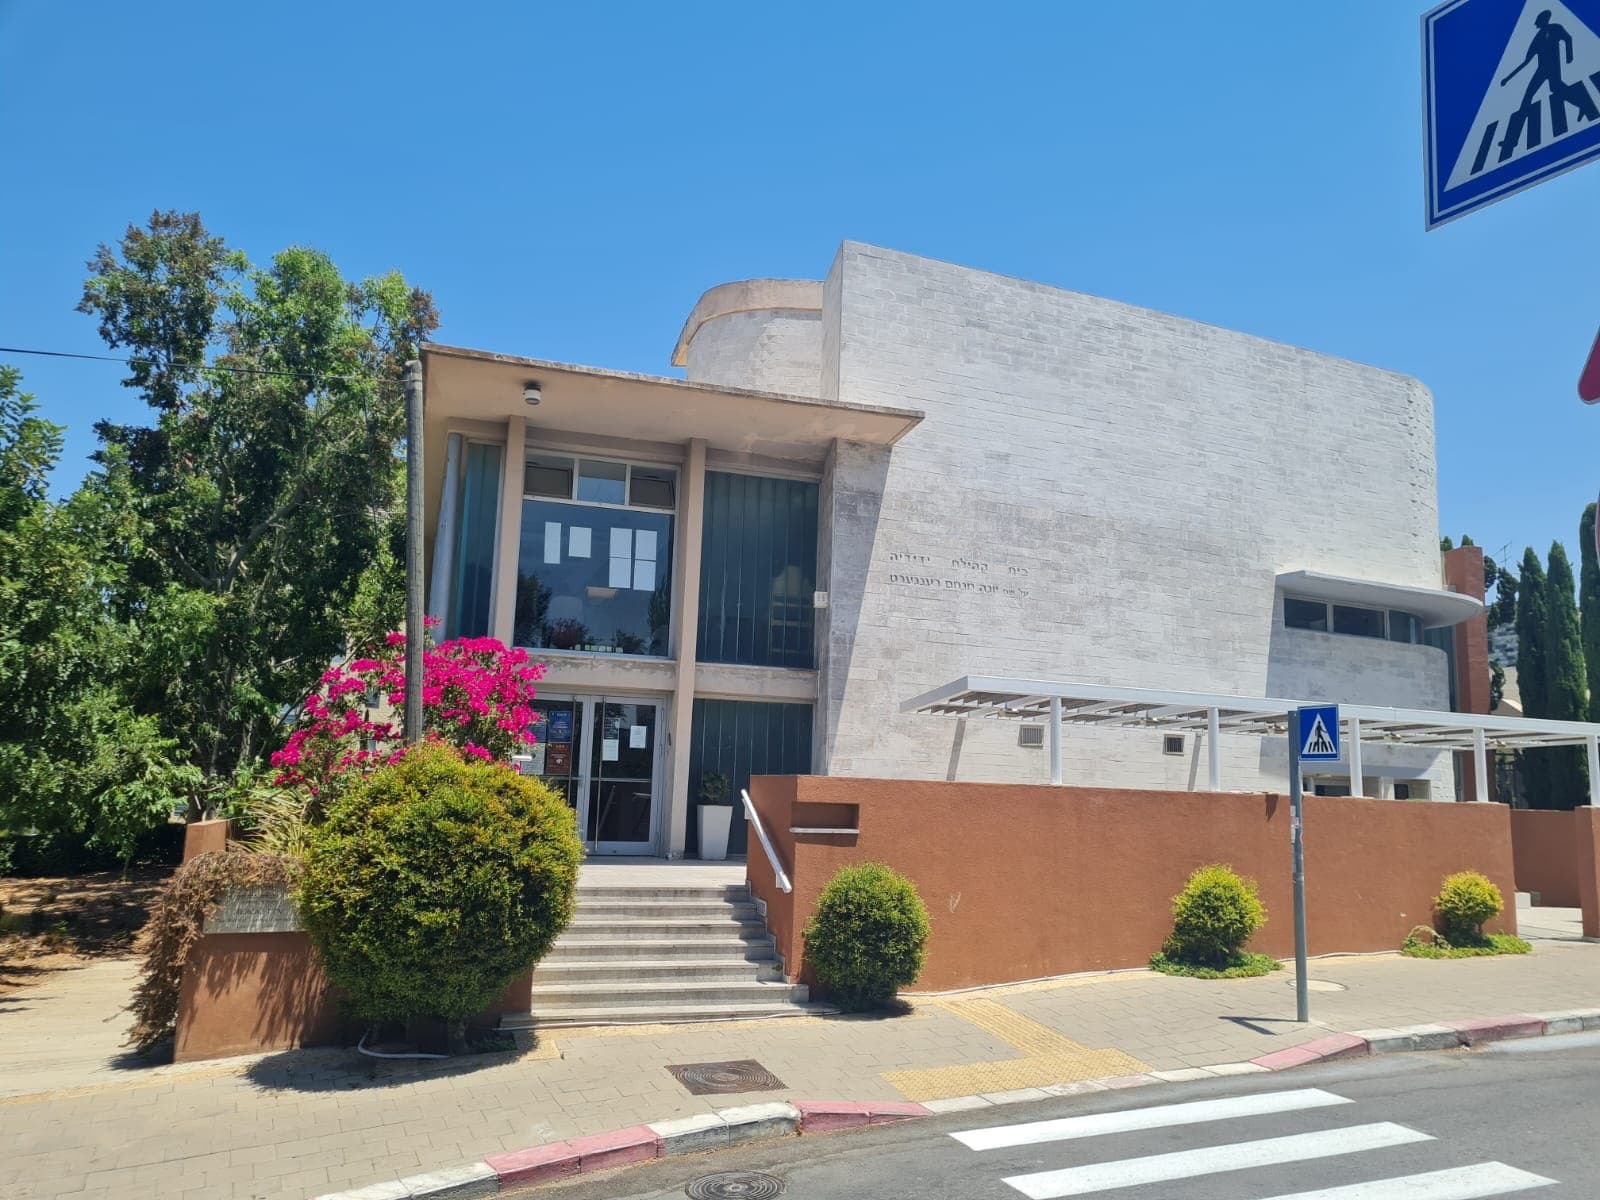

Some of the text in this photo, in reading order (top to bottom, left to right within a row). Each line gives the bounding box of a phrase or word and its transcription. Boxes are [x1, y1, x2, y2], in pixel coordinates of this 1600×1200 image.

[889, 552, 1029, 576] בית קהילת ידידיה
[945, 580, 975, 590] מנחם
